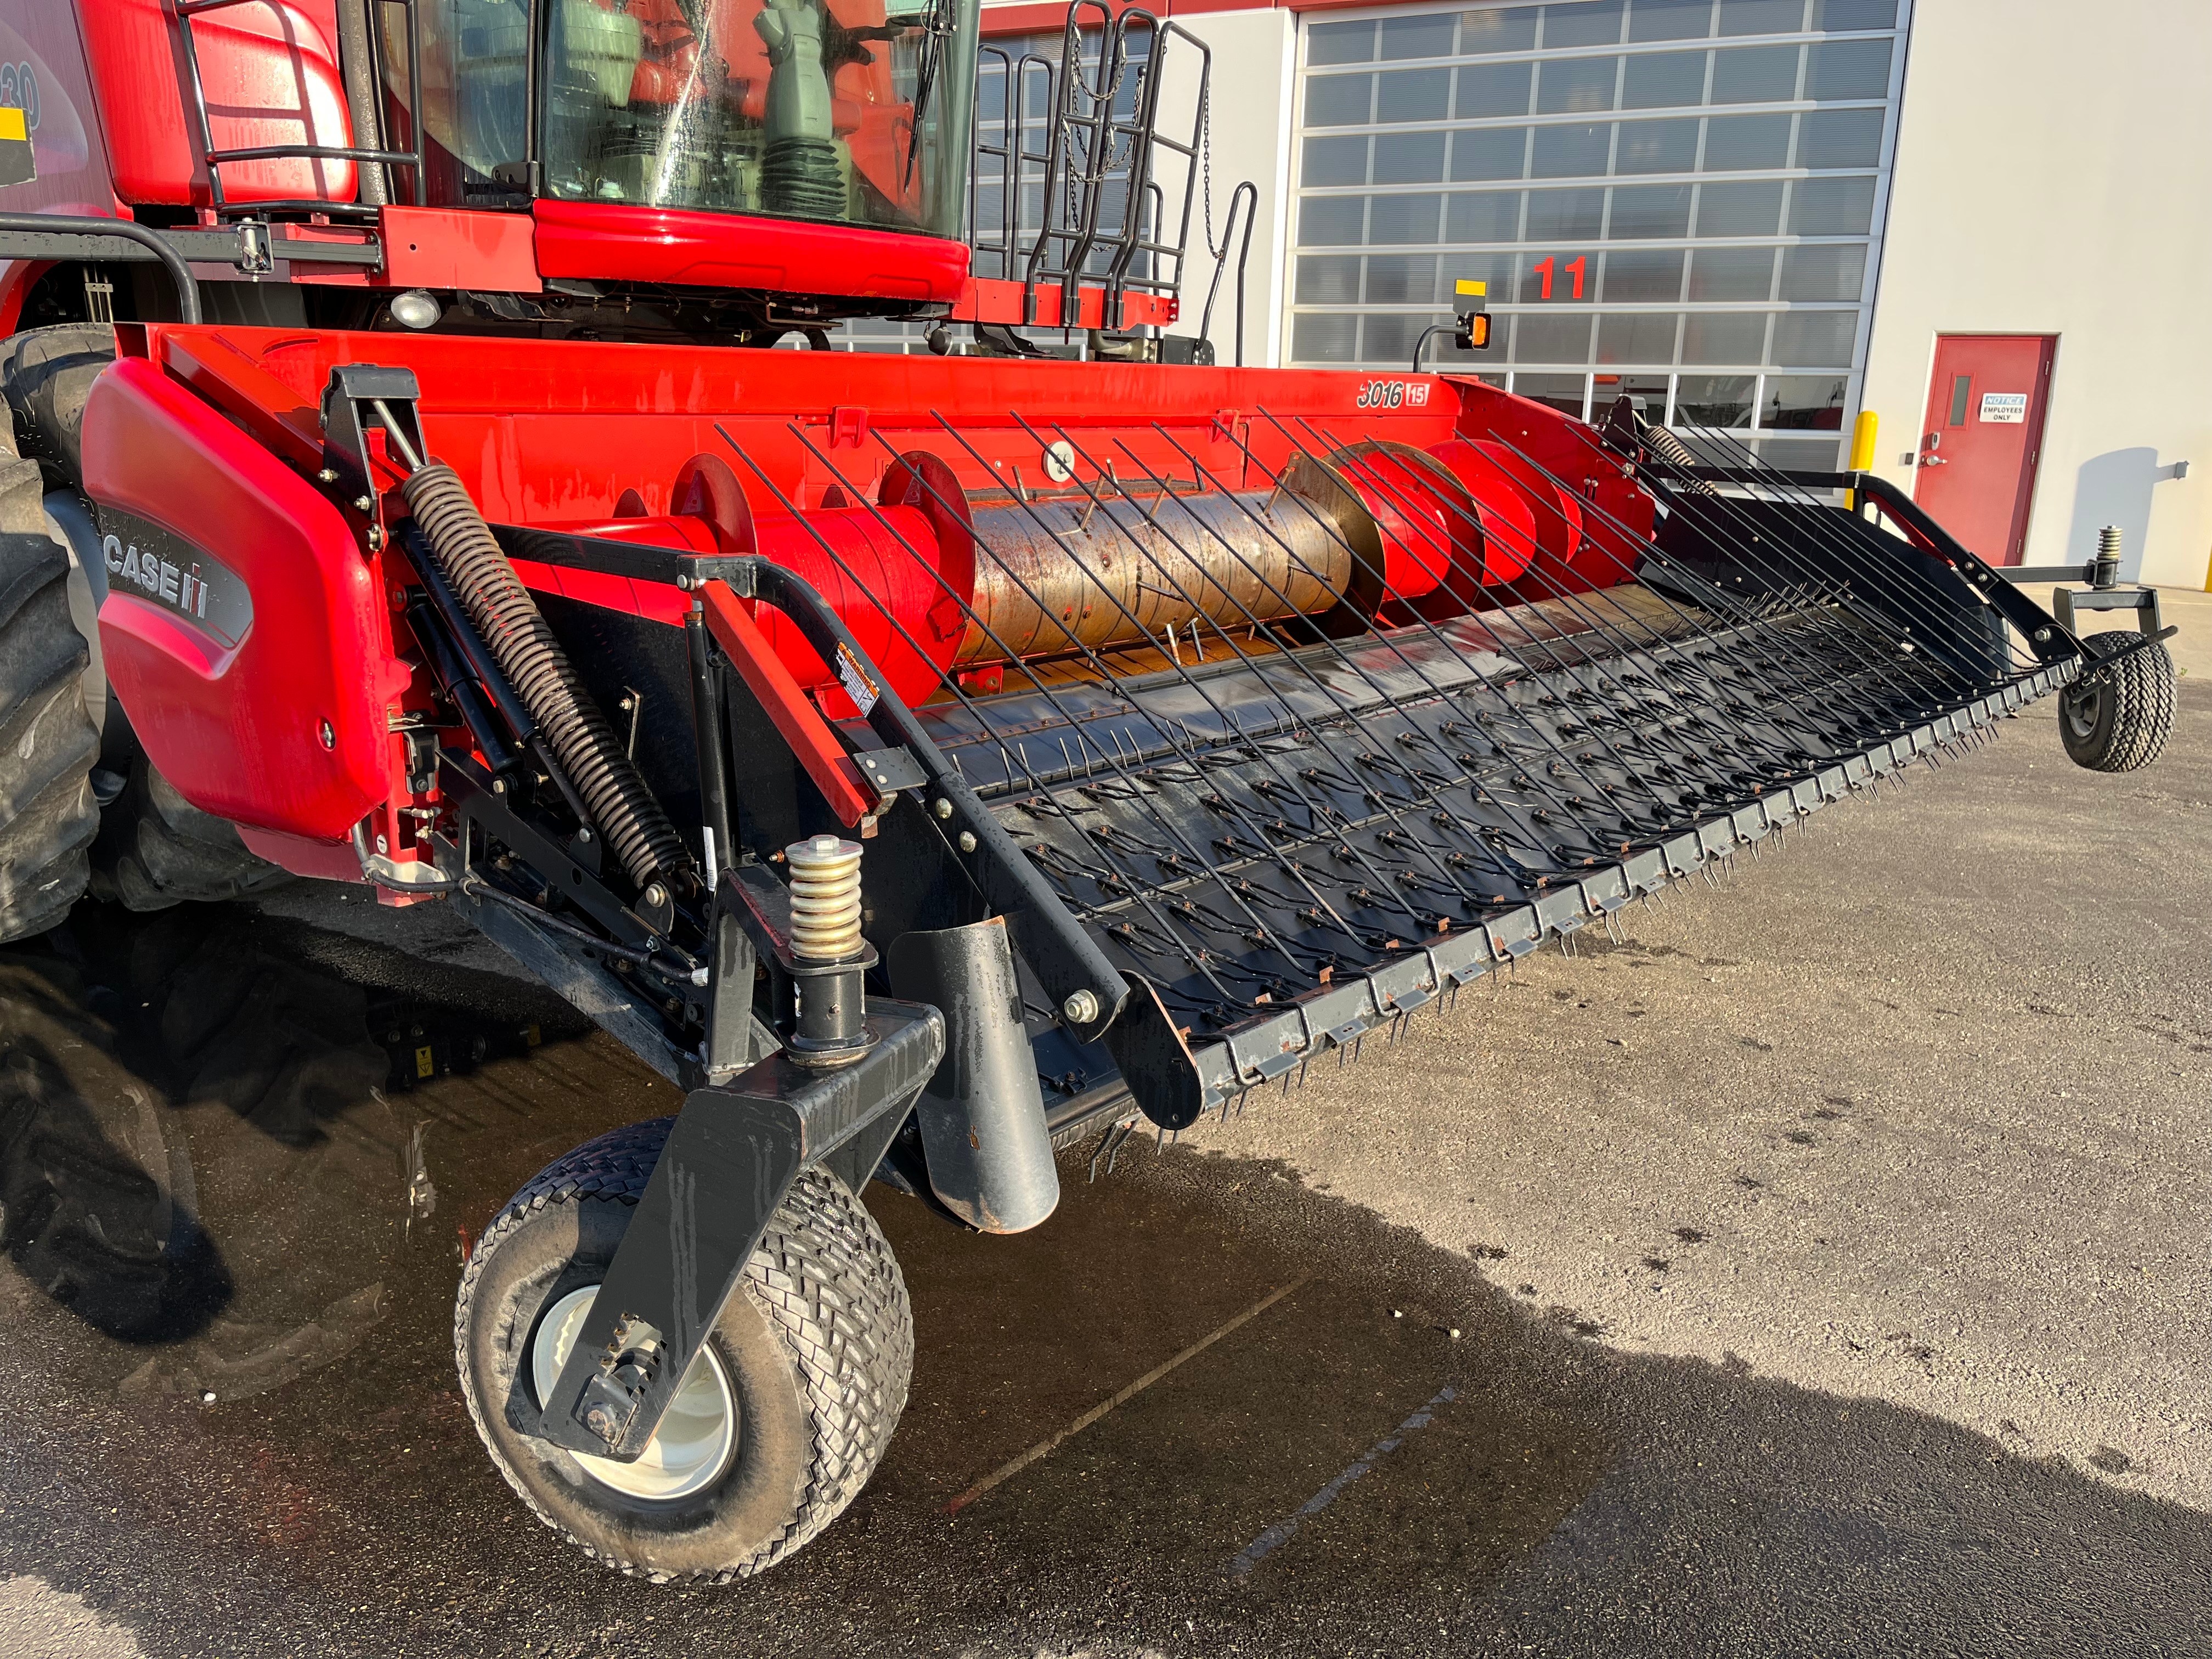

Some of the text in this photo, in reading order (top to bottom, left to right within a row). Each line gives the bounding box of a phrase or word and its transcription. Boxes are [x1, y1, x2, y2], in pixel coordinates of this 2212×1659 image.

[0, 61, 40, 130] 30
[1533, 256, 1586, 299] 11
[1357, 380, 1424, 409] 3016 15
[103, 534, 179, 605] CASE
[848, 656, 872, 688] WARNING
